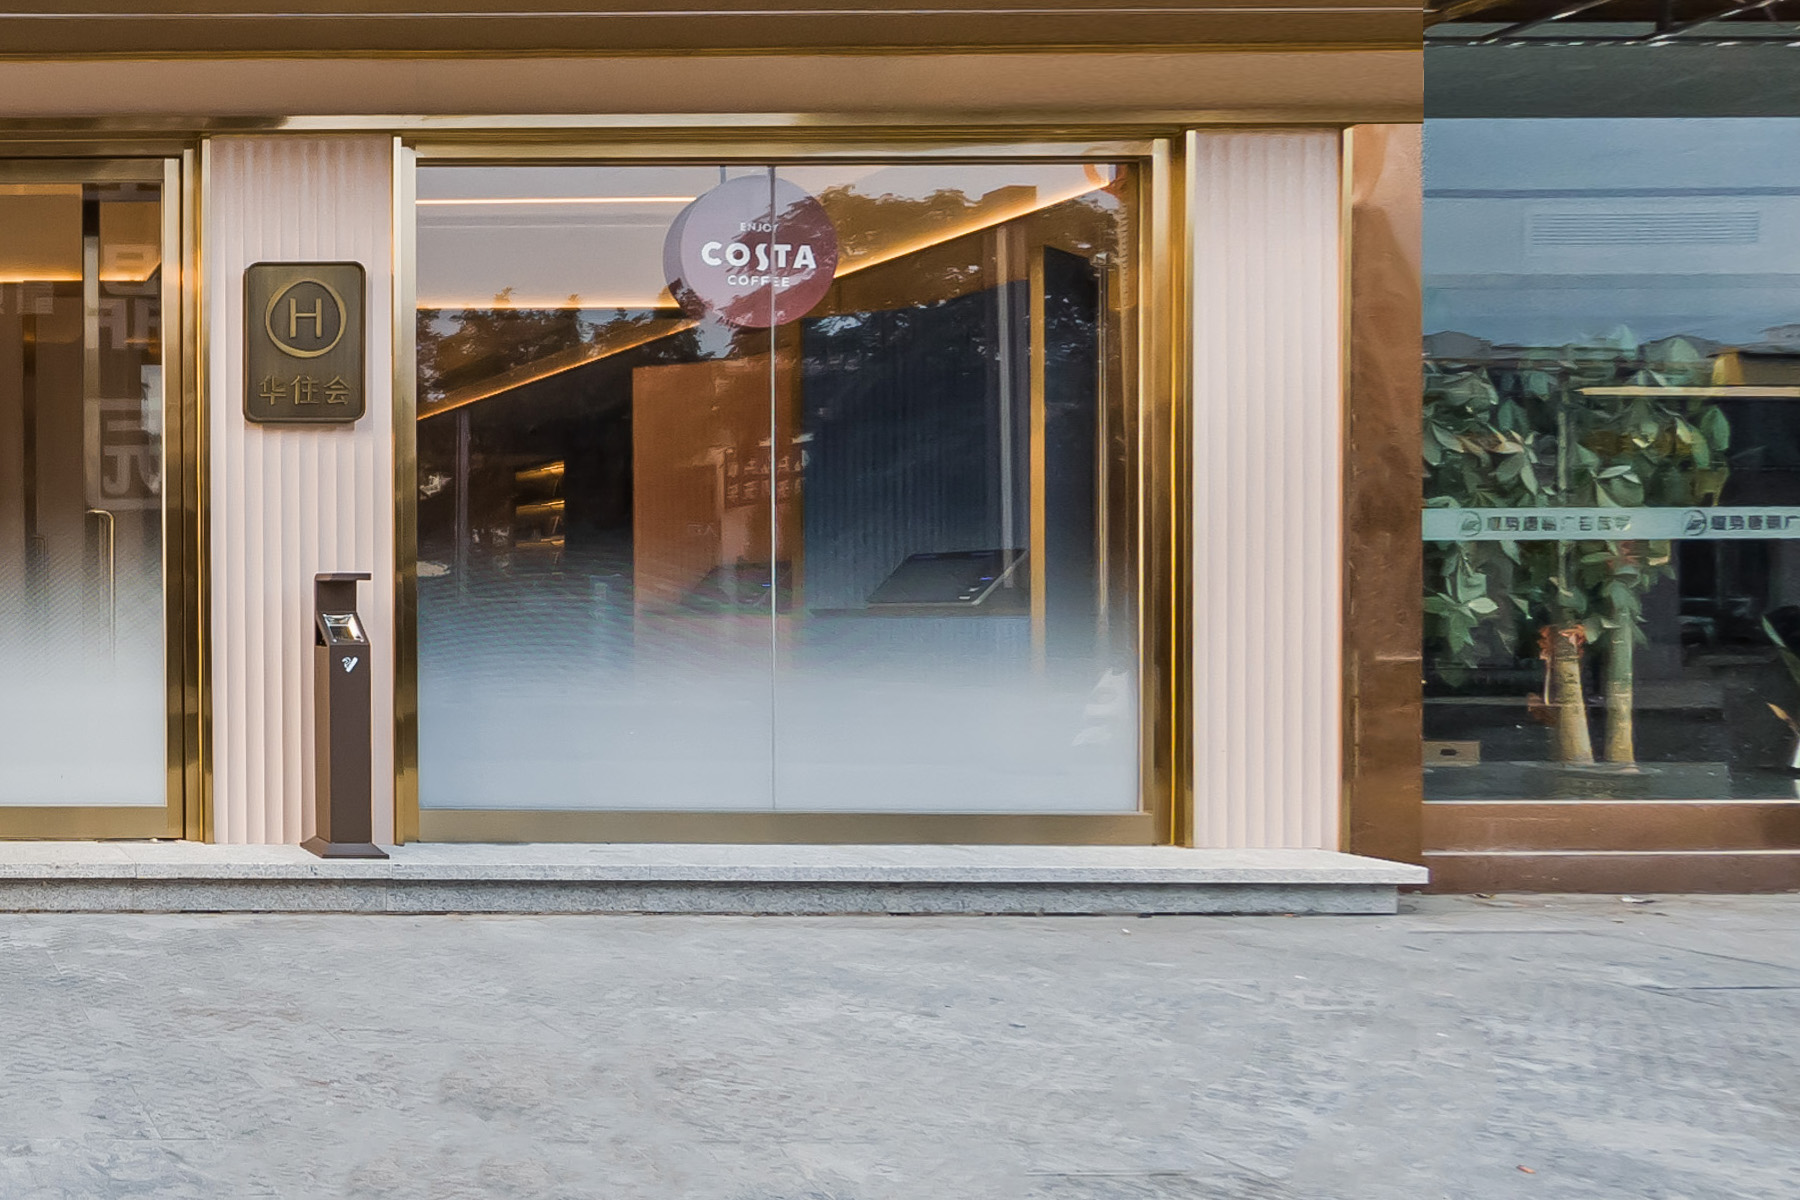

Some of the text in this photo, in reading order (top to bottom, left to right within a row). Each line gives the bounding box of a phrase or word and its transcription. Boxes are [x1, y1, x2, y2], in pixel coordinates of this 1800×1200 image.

[740, 222, 780, 233] ENJOY
[701, 241, 817, 271] COSTA
[727, 274, 791, 287] COFFEE
[289, 297, 323, 339] H
[259, 375, 351, 406] 华住会
